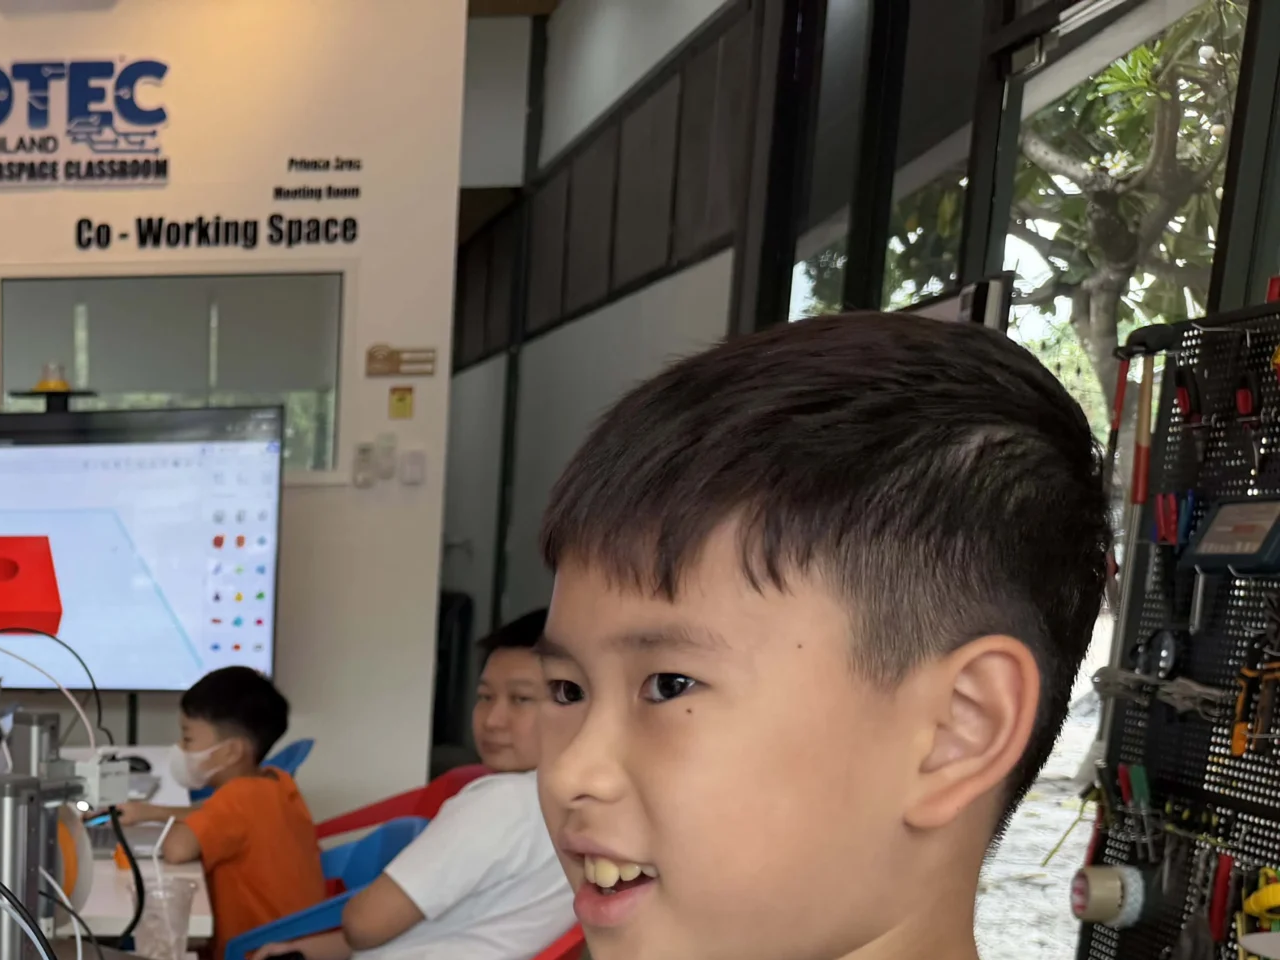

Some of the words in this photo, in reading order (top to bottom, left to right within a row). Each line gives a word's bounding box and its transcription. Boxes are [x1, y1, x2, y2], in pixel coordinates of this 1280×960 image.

[64, 157, 169, 181] CLASSROOM
[76, 217, 111, 250] Co
[136, 214, 259, 250] Working
[267, 213, 358, 248] Space
